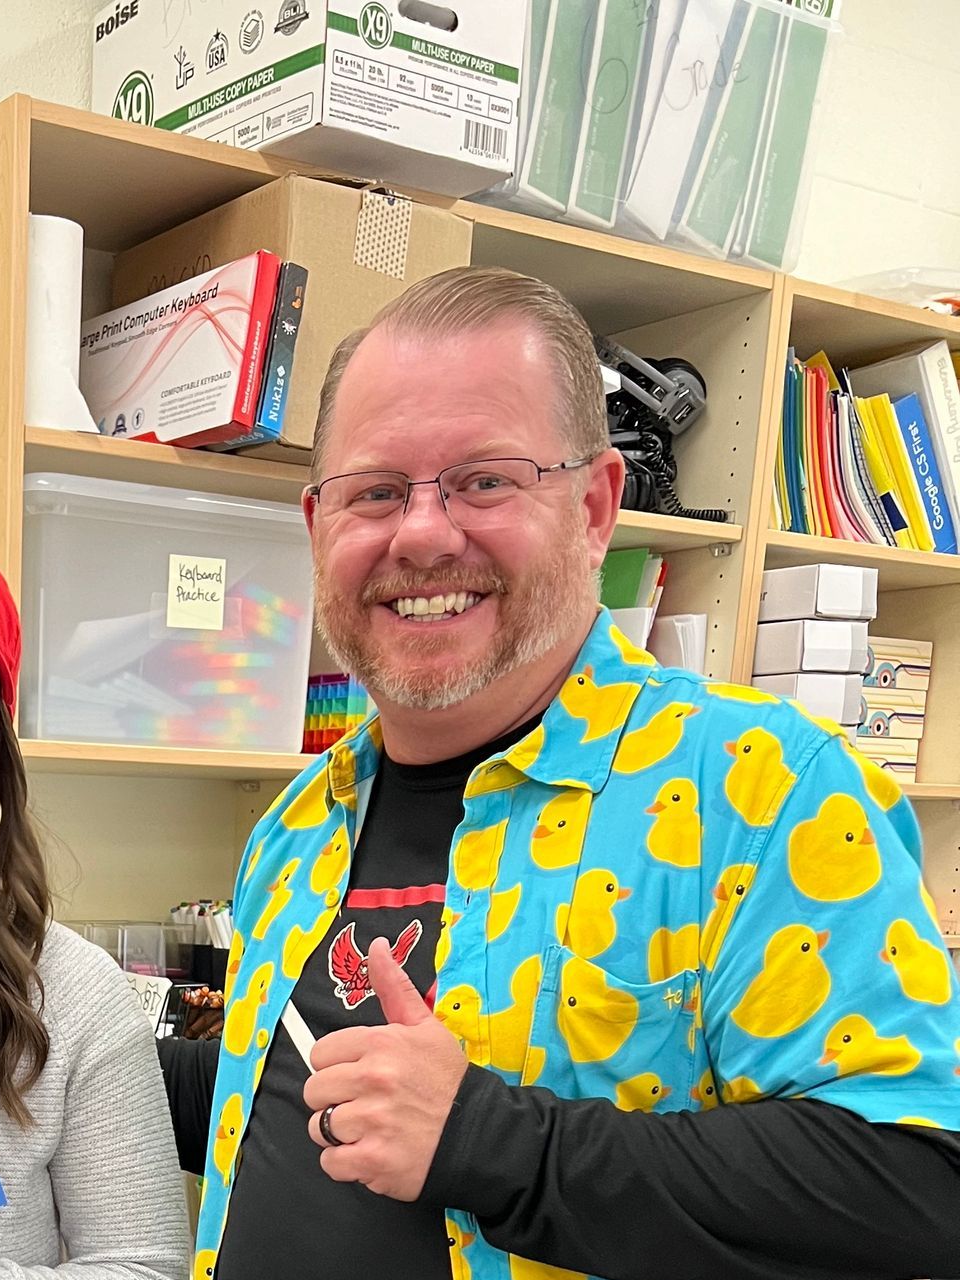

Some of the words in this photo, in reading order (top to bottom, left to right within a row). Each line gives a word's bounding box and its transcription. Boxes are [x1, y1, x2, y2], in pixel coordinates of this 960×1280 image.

[364, 8, 387, 42] X9
[208, 48, 226, 69] USA
[411, 39, 451, 60] MULTI-USE
[450, 49, 471, 67] COPY
[471, 55, 495, 75] PAPER
[187, 90, 226, 120] MULTI-USE
[225, 81, 247, 102] COPY
[247, 67, 275, 93] PAPER
[80, 327, 100, 351] arge
[101, 319, 123, 341] Print
[123, 303, 170, 333] Computer
[170, 282, 219, 317] Keyboard
[268, 377, 284, 422] Nuklz
[907, 421, 923, 453] First
[916, 453, 929, 476] CS
[925, 476, 944, 530] Google
[179, 563, 223, 588] Keyboard
[176, 585, 221, 603] Practice
